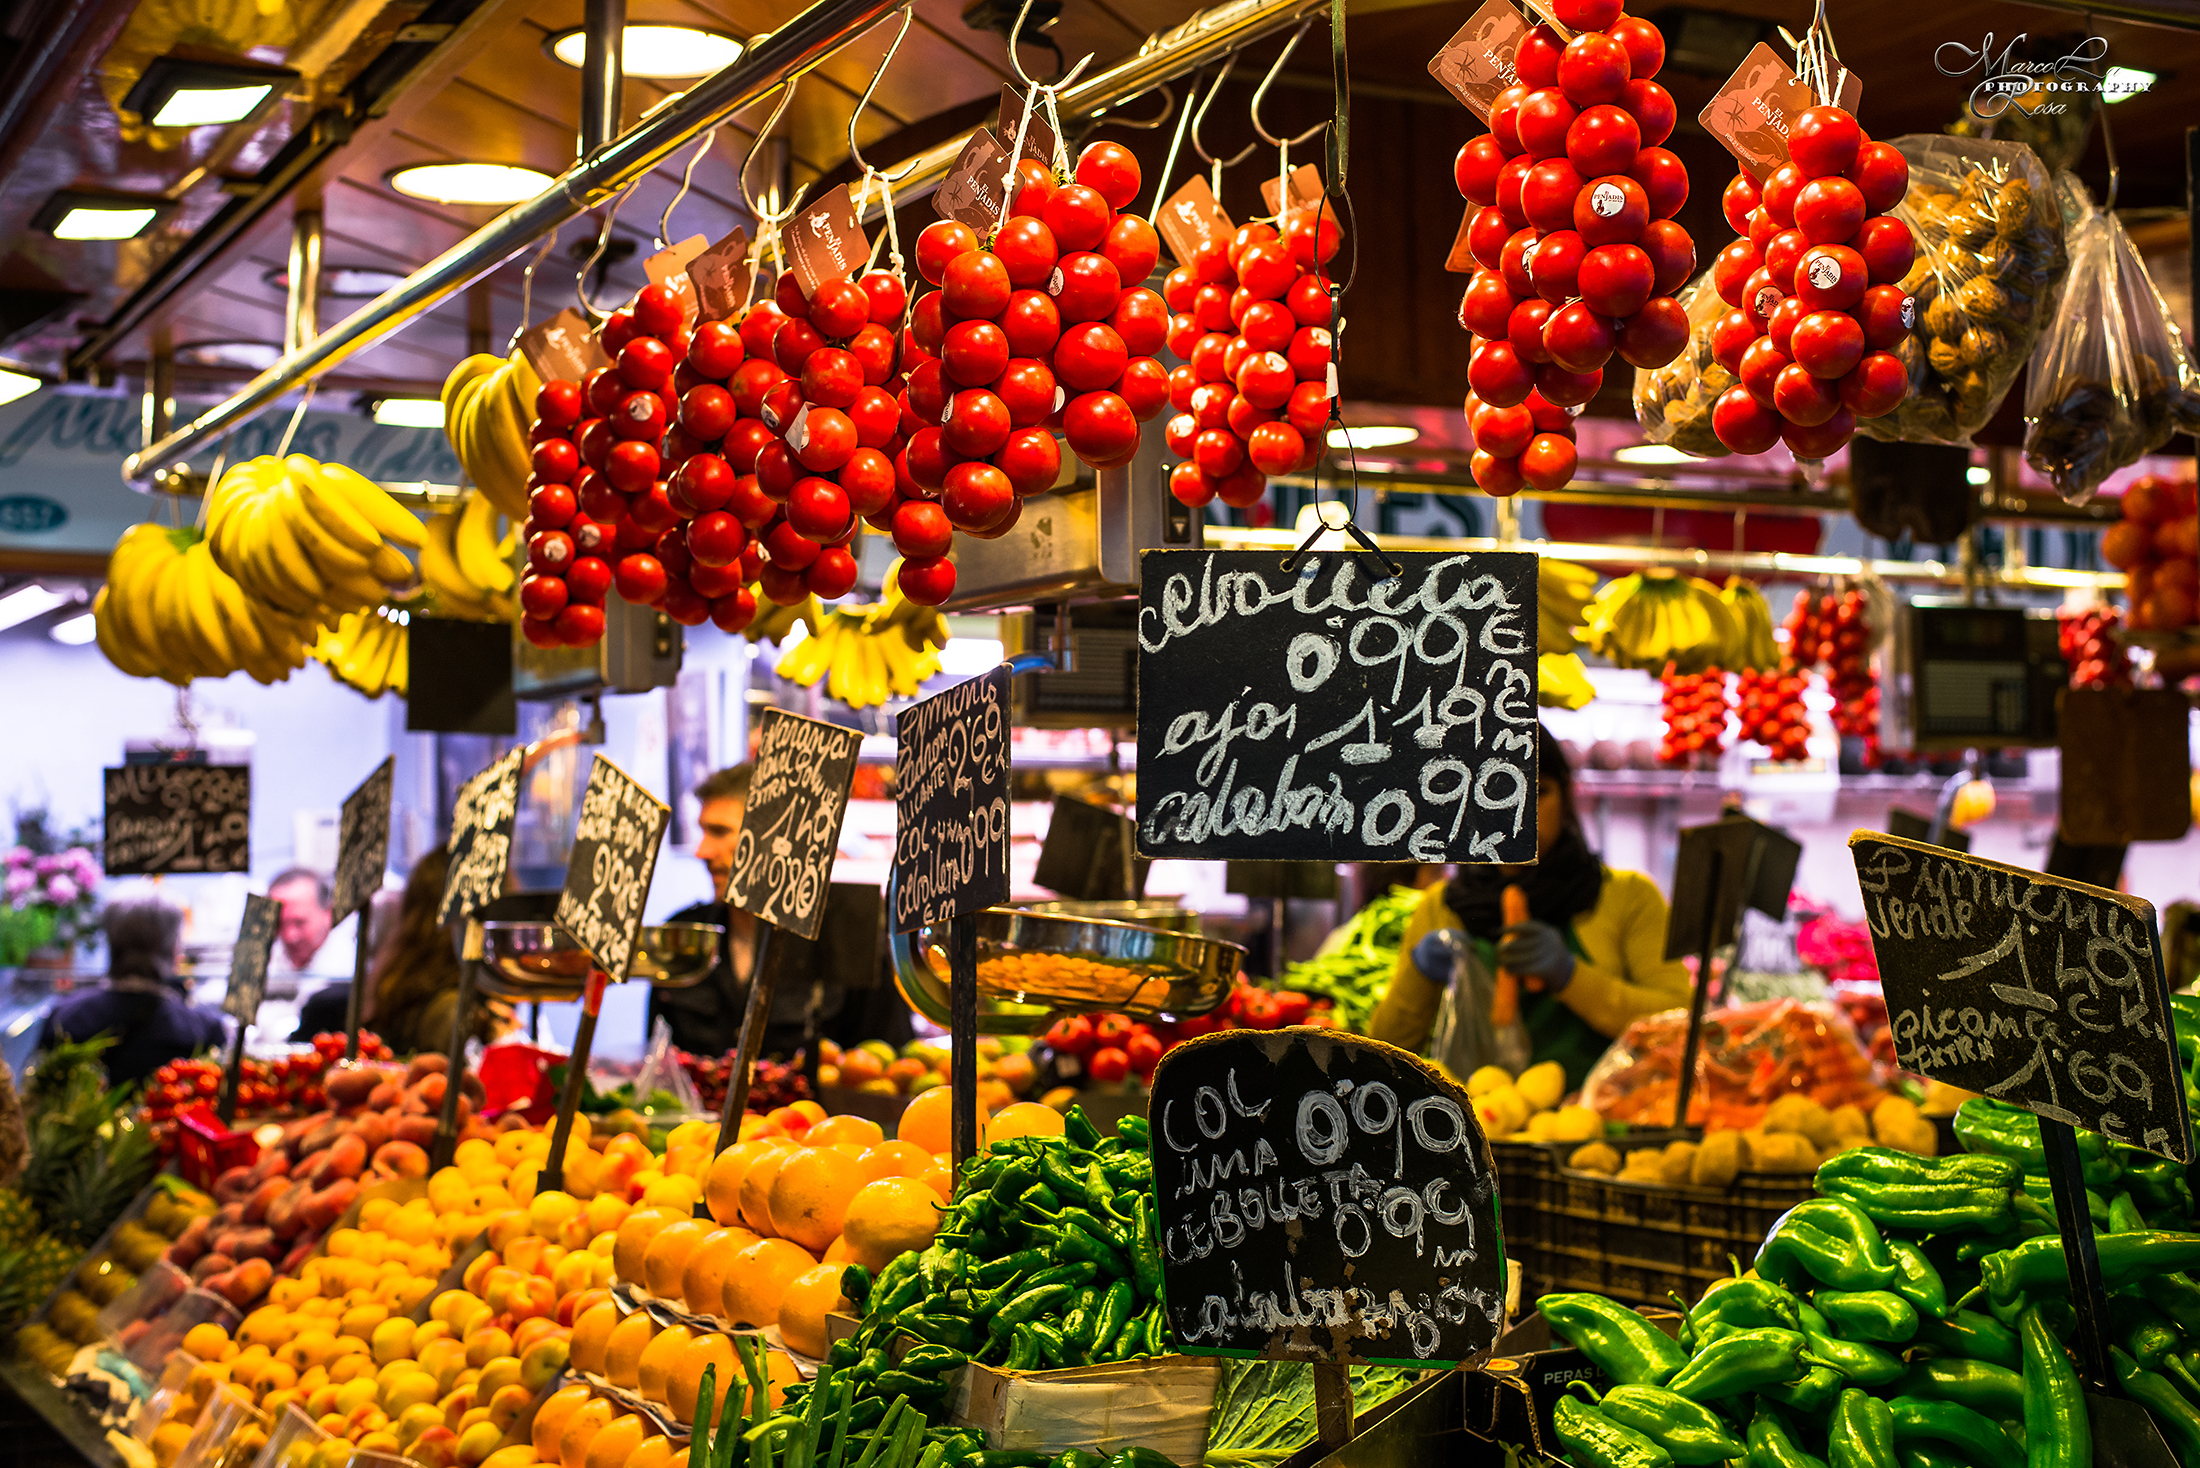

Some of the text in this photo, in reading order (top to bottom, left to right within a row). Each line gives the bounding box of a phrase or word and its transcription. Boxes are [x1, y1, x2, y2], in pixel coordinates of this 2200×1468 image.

[1774, 107, 1784, 120] EL
[1163, 1067, 1272, 1153] COL
[1543, 1367, 1593, 1385] PERAS
